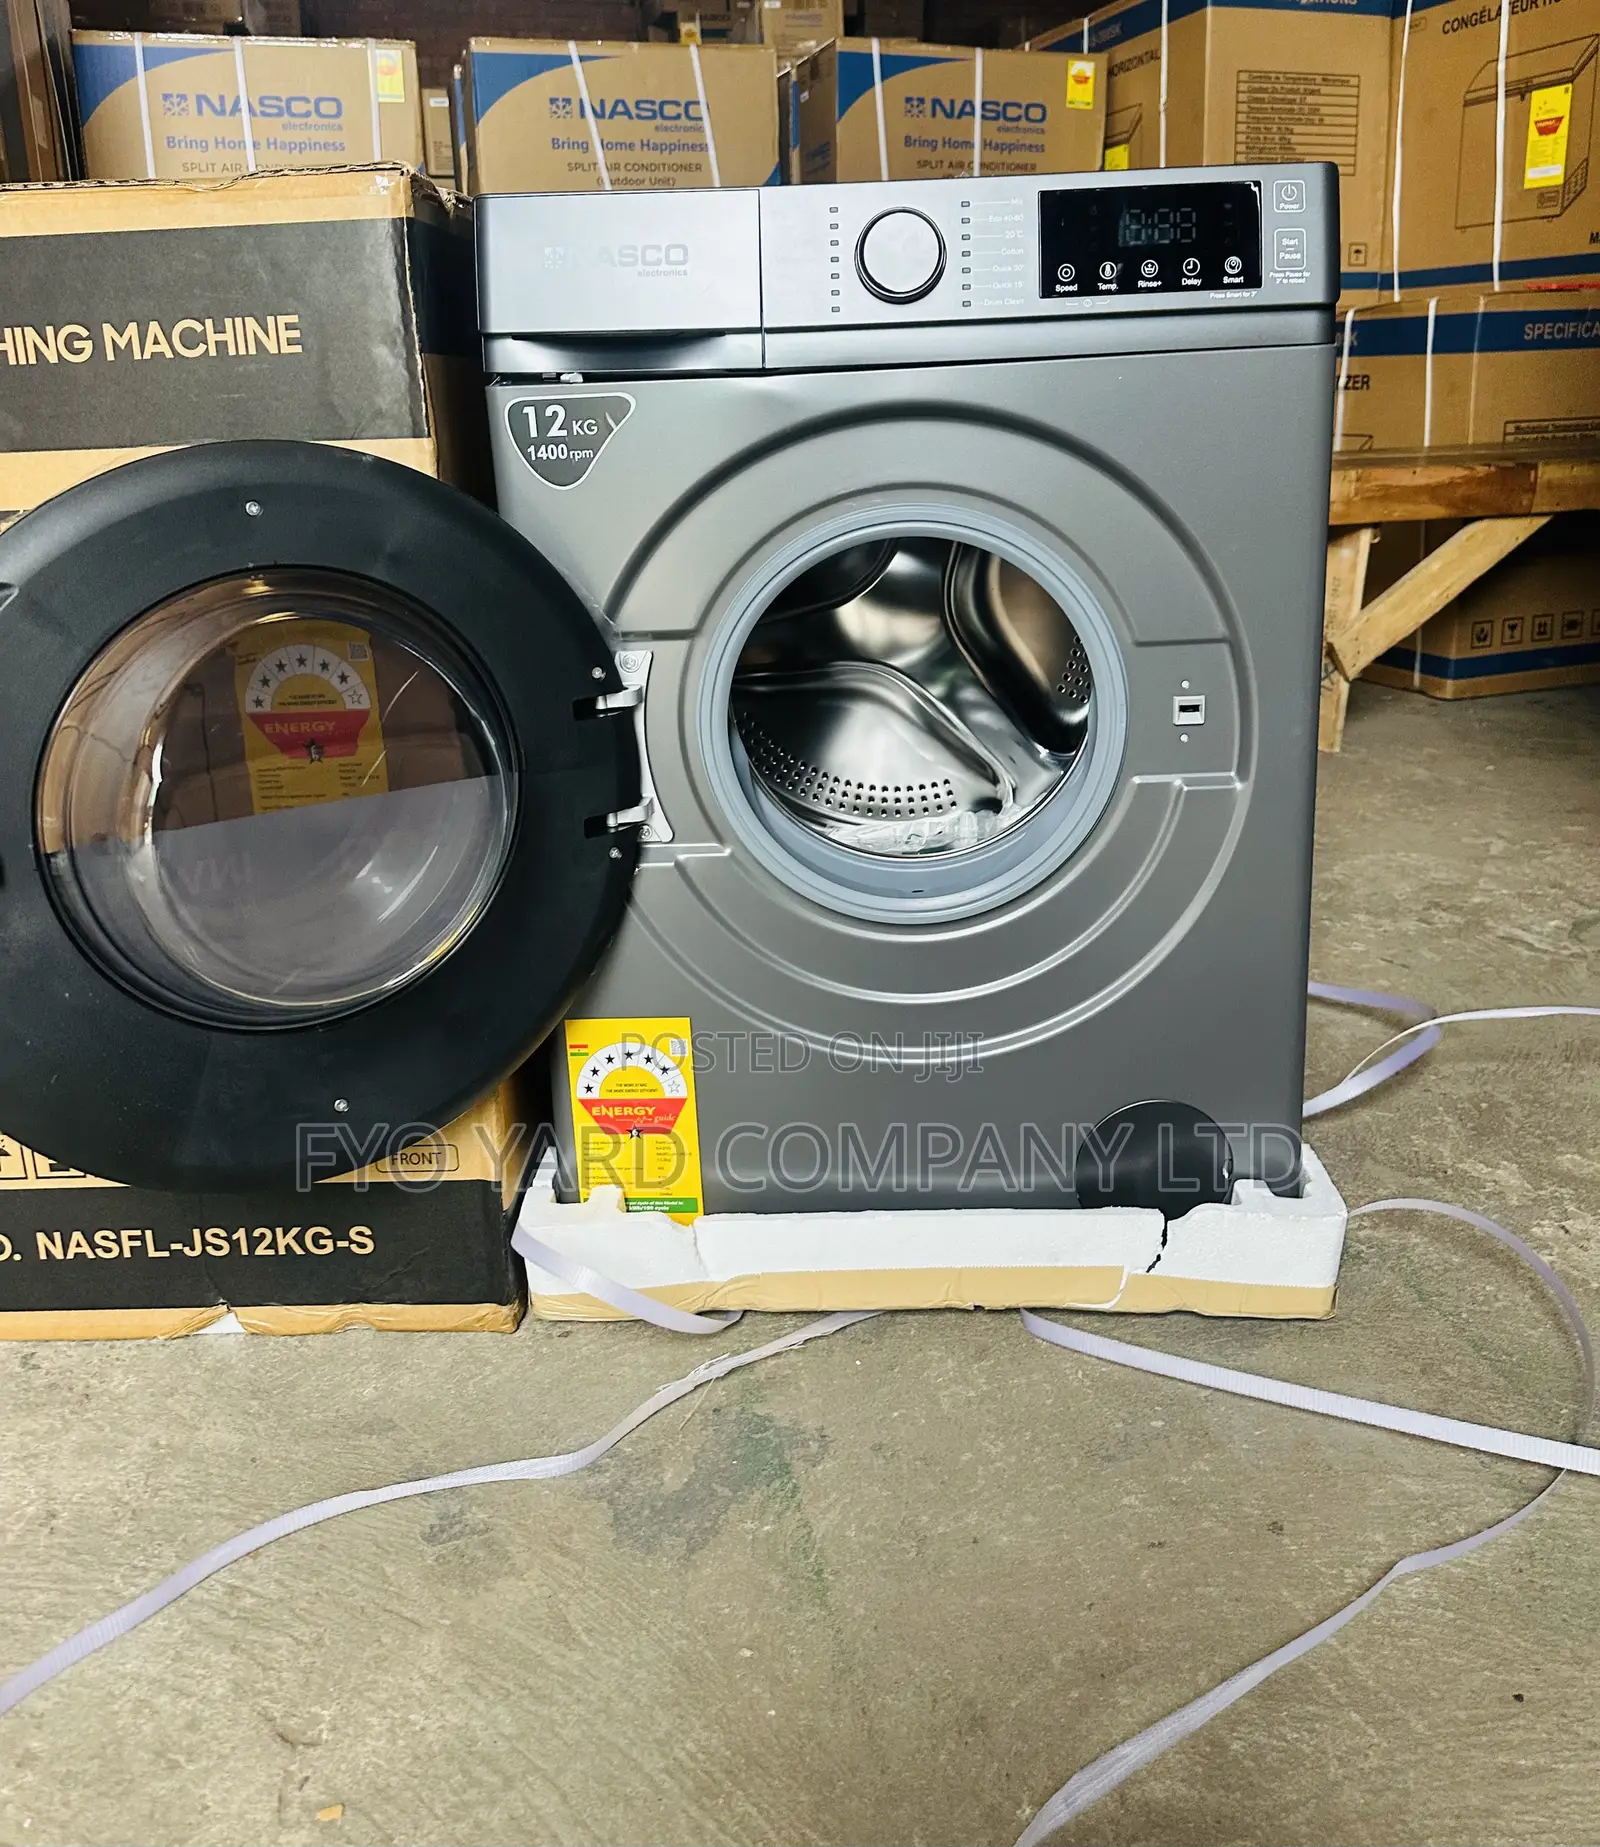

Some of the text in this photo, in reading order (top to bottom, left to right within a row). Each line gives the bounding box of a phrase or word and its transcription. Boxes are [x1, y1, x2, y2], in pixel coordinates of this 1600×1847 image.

[1442, 0, 1539, 34] CONGÉLAEUR
[195, 94, 342, 119] NASCO
[931, 97, 1047, 123] NASCO
[282, 121, 343, 132] electronics
[655, 123, 705, 133] electronic
[166, 136, 209, 153] Bring
[266, 138, 346, 154] Happiness
[551, 137, 589, 154] Bring
[904, 135, 938, 151] Bring
[984, 139, 1046, 155] Happiness
[182, 163, 217, 173] SPLIT
[221, 163, 242, 173] AIR
[567, 162, 598, 173] SPLIT
[623, 163, 703, 174] CONDITIONER
[917, 160, 1038, 173] SPLIT AIR CNDITIONER
[597, 175, 646, 187] (utdoor
[1279, 202, 1300, 210] Power
[1281, 237, 1299, 246] Start
[1279, 252, 1301, 260] Pause
[637, 268, 688, 278] electronics
[1137, 279, 1163, 288] Rinse+
[1181, 277, 1202, 287] Delay
[1222, 275, 1245, 285] Smart
[1055, 283, 1078, 293] Speed
[1097, 282, 1119, 292] Temp.
[102, 314, 303, 362] MACHINE
[522, 404, 598, 438] 12 KG
[527, 443, 594, 462] 1400 rpm
[264, 720, 336, 737] ENERGY
[591, 1104, 656, 1118] ENERGY
[653, 1113, 675, 1124] guide
[391, 1152, 442, 1166] FRONT
[36, 1226, 375, 1260] NASFL-JS12KG-S
